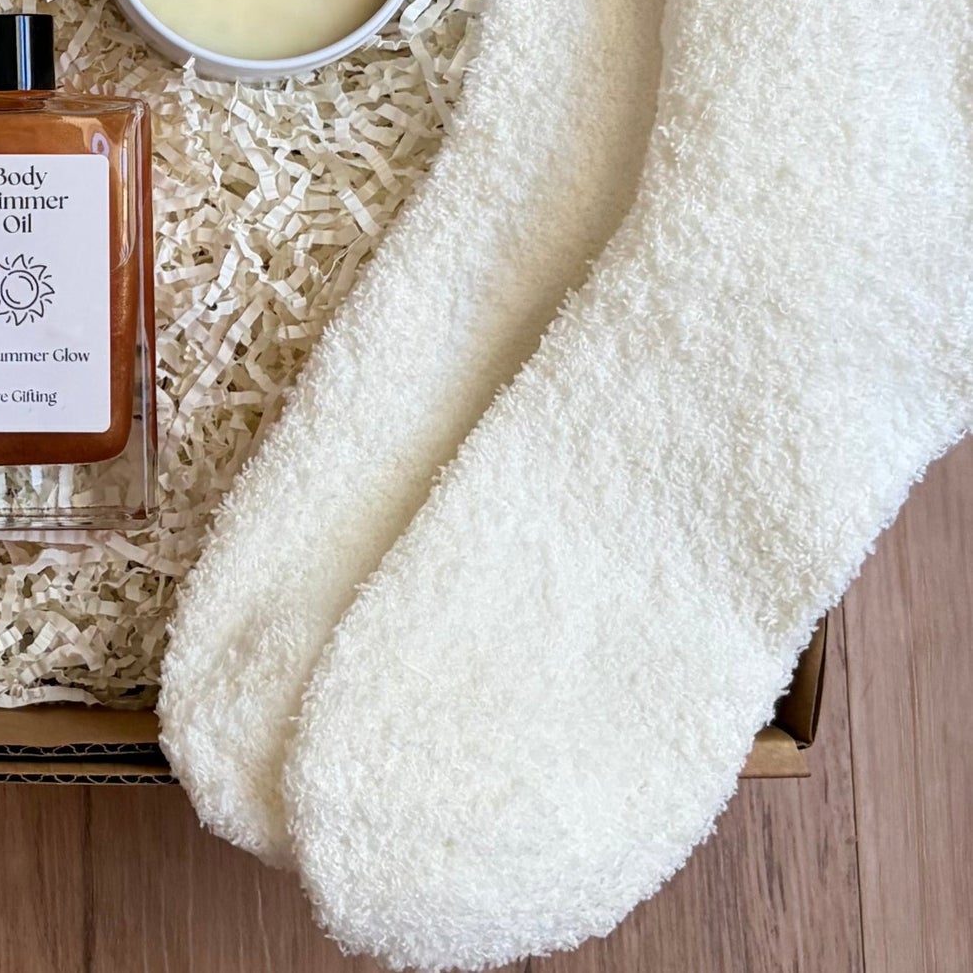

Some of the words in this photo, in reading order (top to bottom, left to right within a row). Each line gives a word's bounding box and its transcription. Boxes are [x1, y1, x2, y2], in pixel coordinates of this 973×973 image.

[3, 213, 32, 233] Oil
[52, 348, 90, 362] Glow
[11, 389, 57, 407] Gifting
